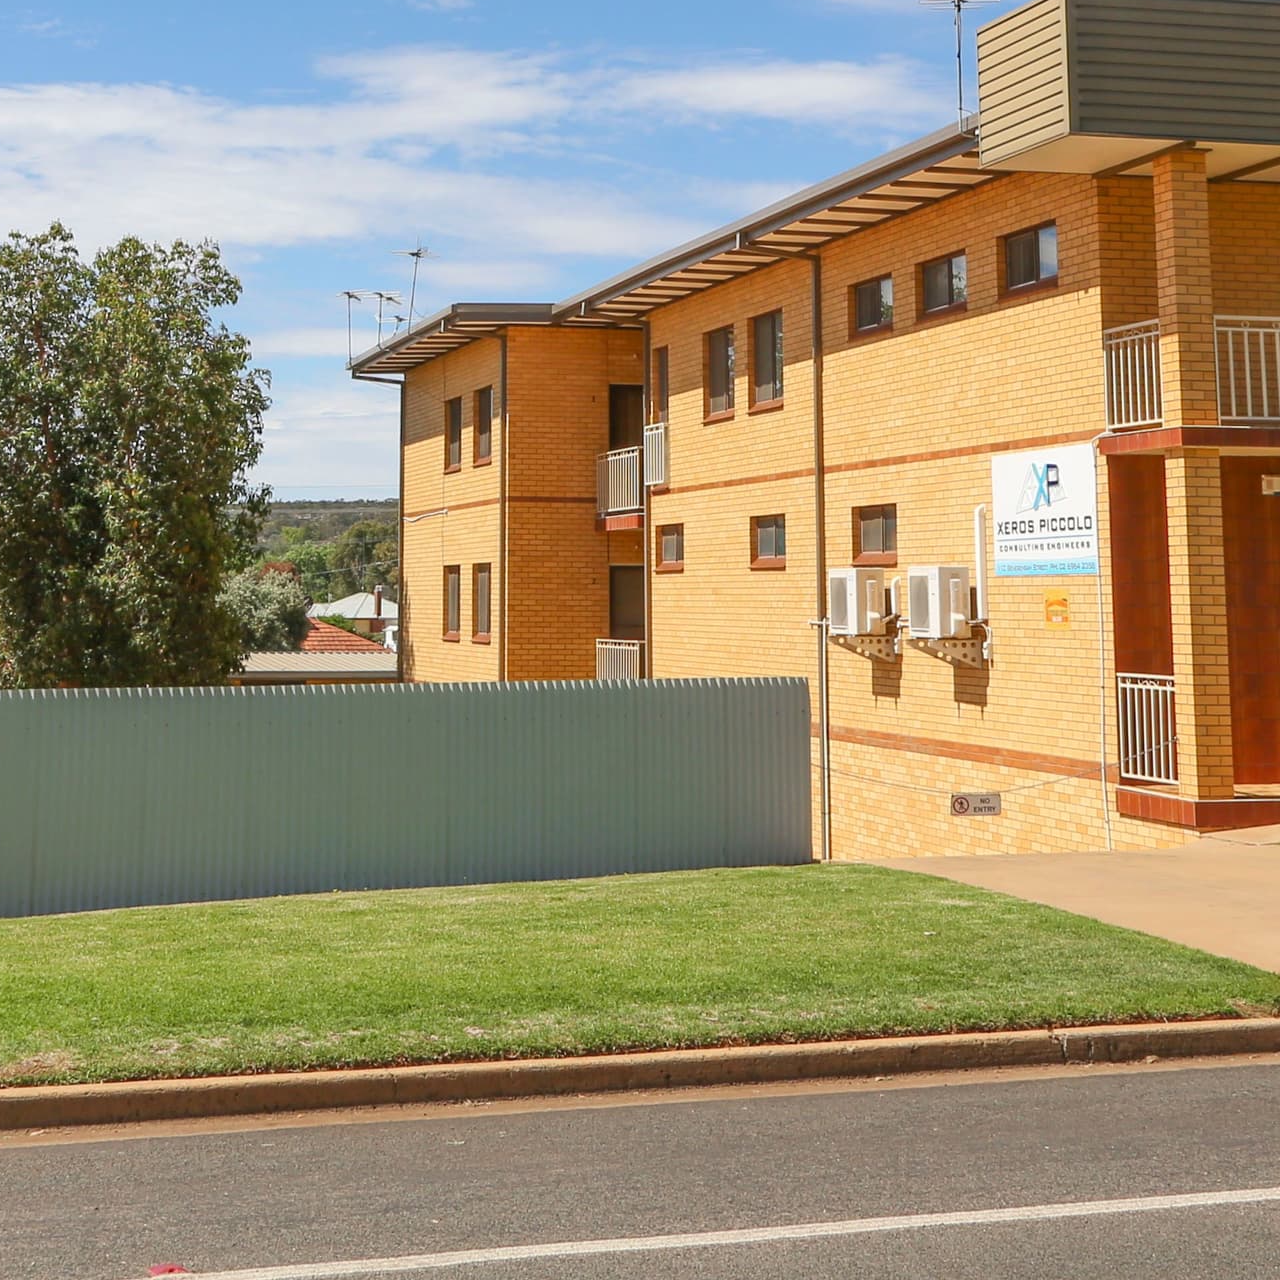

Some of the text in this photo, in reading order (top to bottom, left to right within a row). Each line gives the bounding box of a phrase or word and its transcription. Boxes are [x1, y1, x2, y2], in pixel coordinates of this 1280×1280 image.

[1032, 463, 1060, 511] XP
[997, 515, 1093, 535] XEROS PICCOLO
[999, 540, 1091, 553] CONSULTING ENGINEERS
